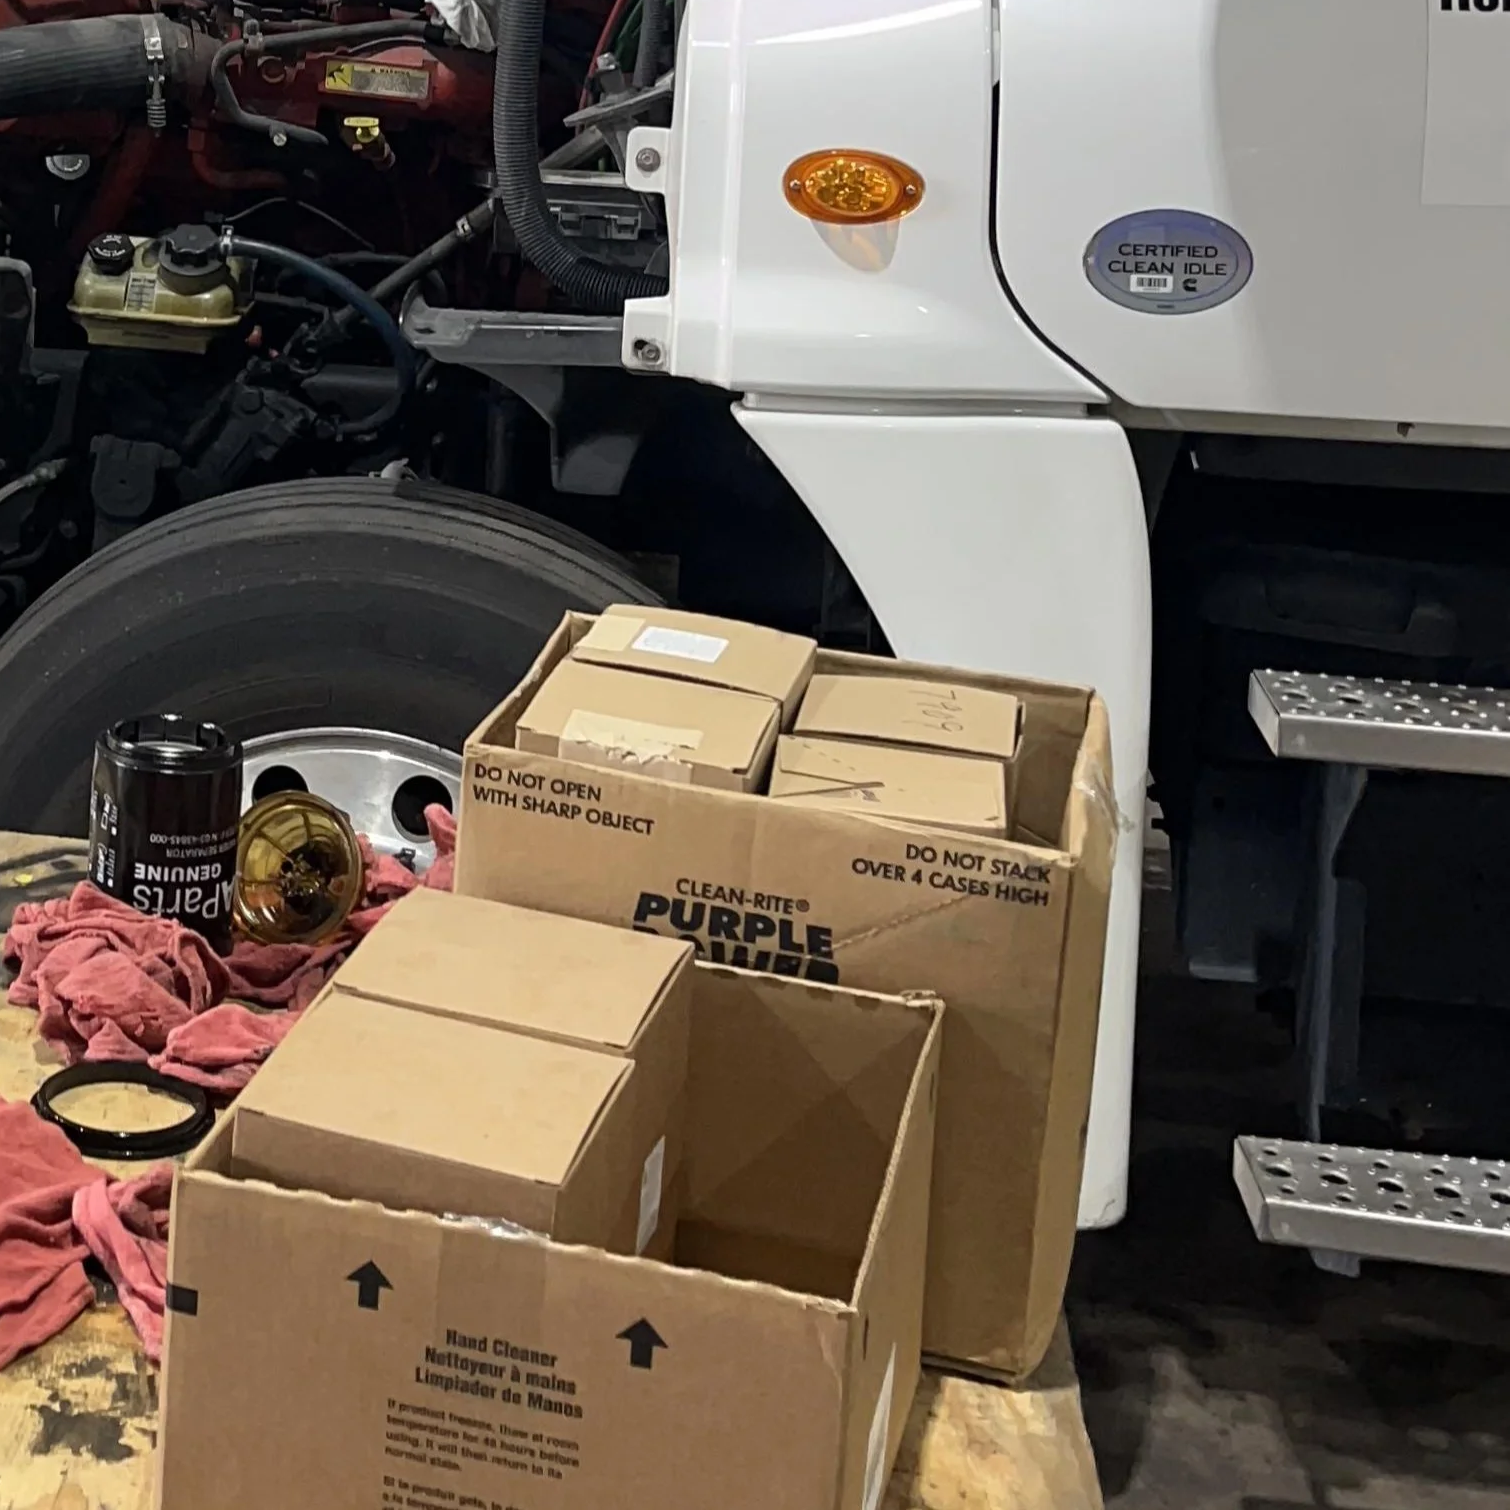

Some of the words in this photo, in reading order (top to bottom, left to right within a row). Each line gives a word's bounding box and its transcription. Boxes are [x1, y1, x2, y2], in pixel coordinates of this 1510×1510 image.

[1108, 260, 1174, 274] CLEAN
[1184, 262, 1227, 276] IDLE
[1118, 243, 1218, 258] CERTIFIED
[474, 763, 502, 782] DO
[507, 770, 546, 791] NOT
[550, 779, 602, 802] OPEN
[472, 785, 518, 808] WITH
[522, 795, 581, 820] SHARP
[585, 808, 654, 836] OBJECT
[133, 862, 222, 882] GENUINE
[851, 858, 906, 882] OVER
[910, 869, 922, 885] 4
[929, 872, 989, 896] CASES
[995, 884, 1050, 906] HIGH
[905, 843, 937, 863] DO
[943, 850, 986, 872] NOT
[991, 859, 1051, 883] STACK
[633, 891, 835, 960] PURPLE
[633, 925, 839, 985] WER
[425, 1345, 506, 1379] Nettoyeur
[525, 1372, 577, 1395] mains
[446, 1328, 488, 1353] Hand
[492, 1338, 558, 1368] Cleaner
[415, 1366, 497, 1399] Limpiador
[502, 1388, 521, 1405] de
[527, 1392, 583, 1419] Manos
